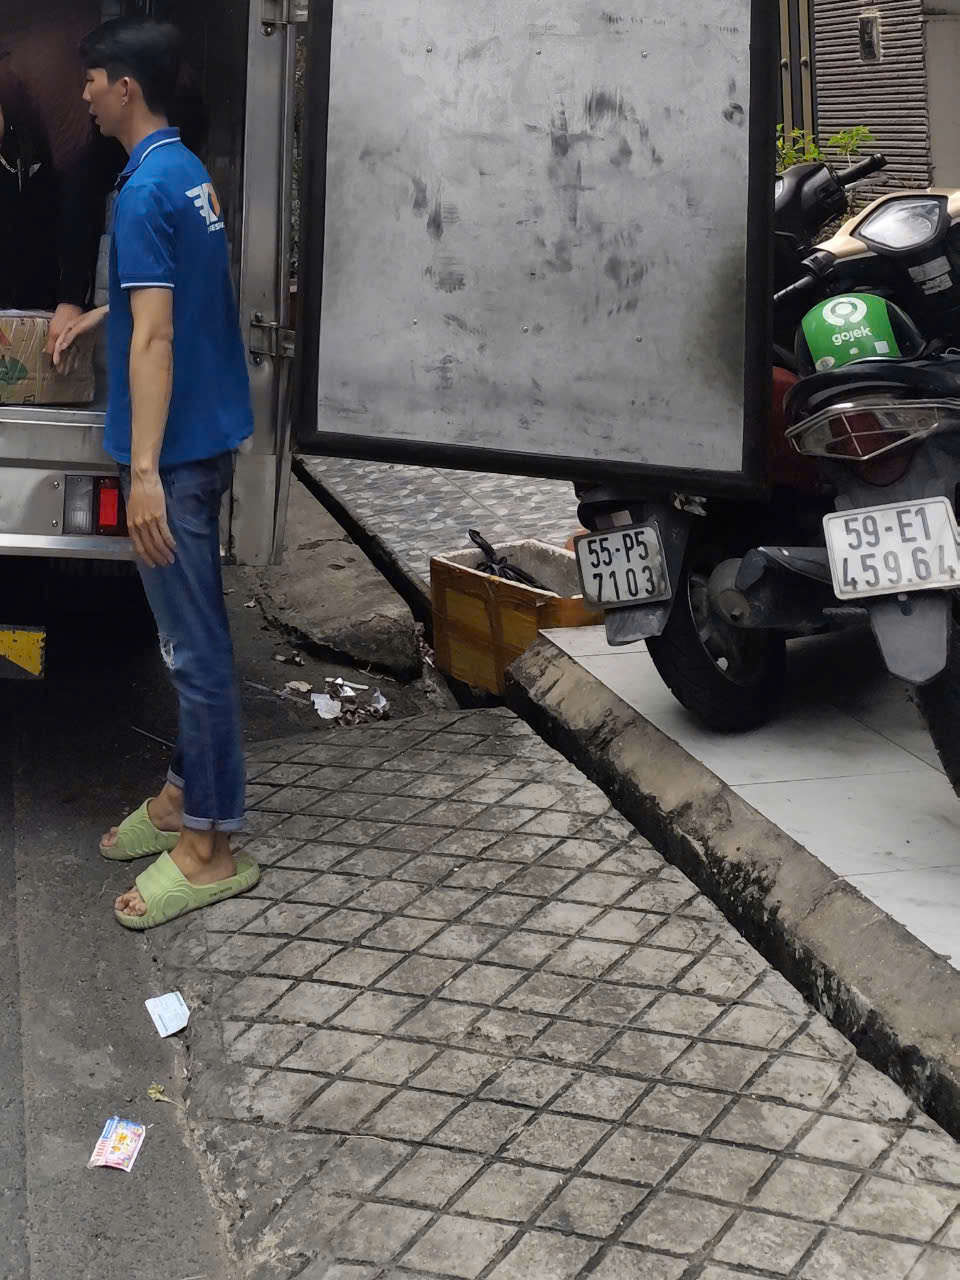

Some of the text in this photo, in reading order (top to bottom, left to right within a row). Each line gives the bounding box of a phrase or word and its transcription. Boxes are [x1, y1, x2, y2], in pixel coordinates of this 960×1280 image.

[831, 326, 872, 346] gojek
[843, 506, 931, 550] 59-E1
[587, 530, 650, 568] 55-P5
[842, 544, 956, 591] 459.64
[592, 565, 656, 602] 7103
